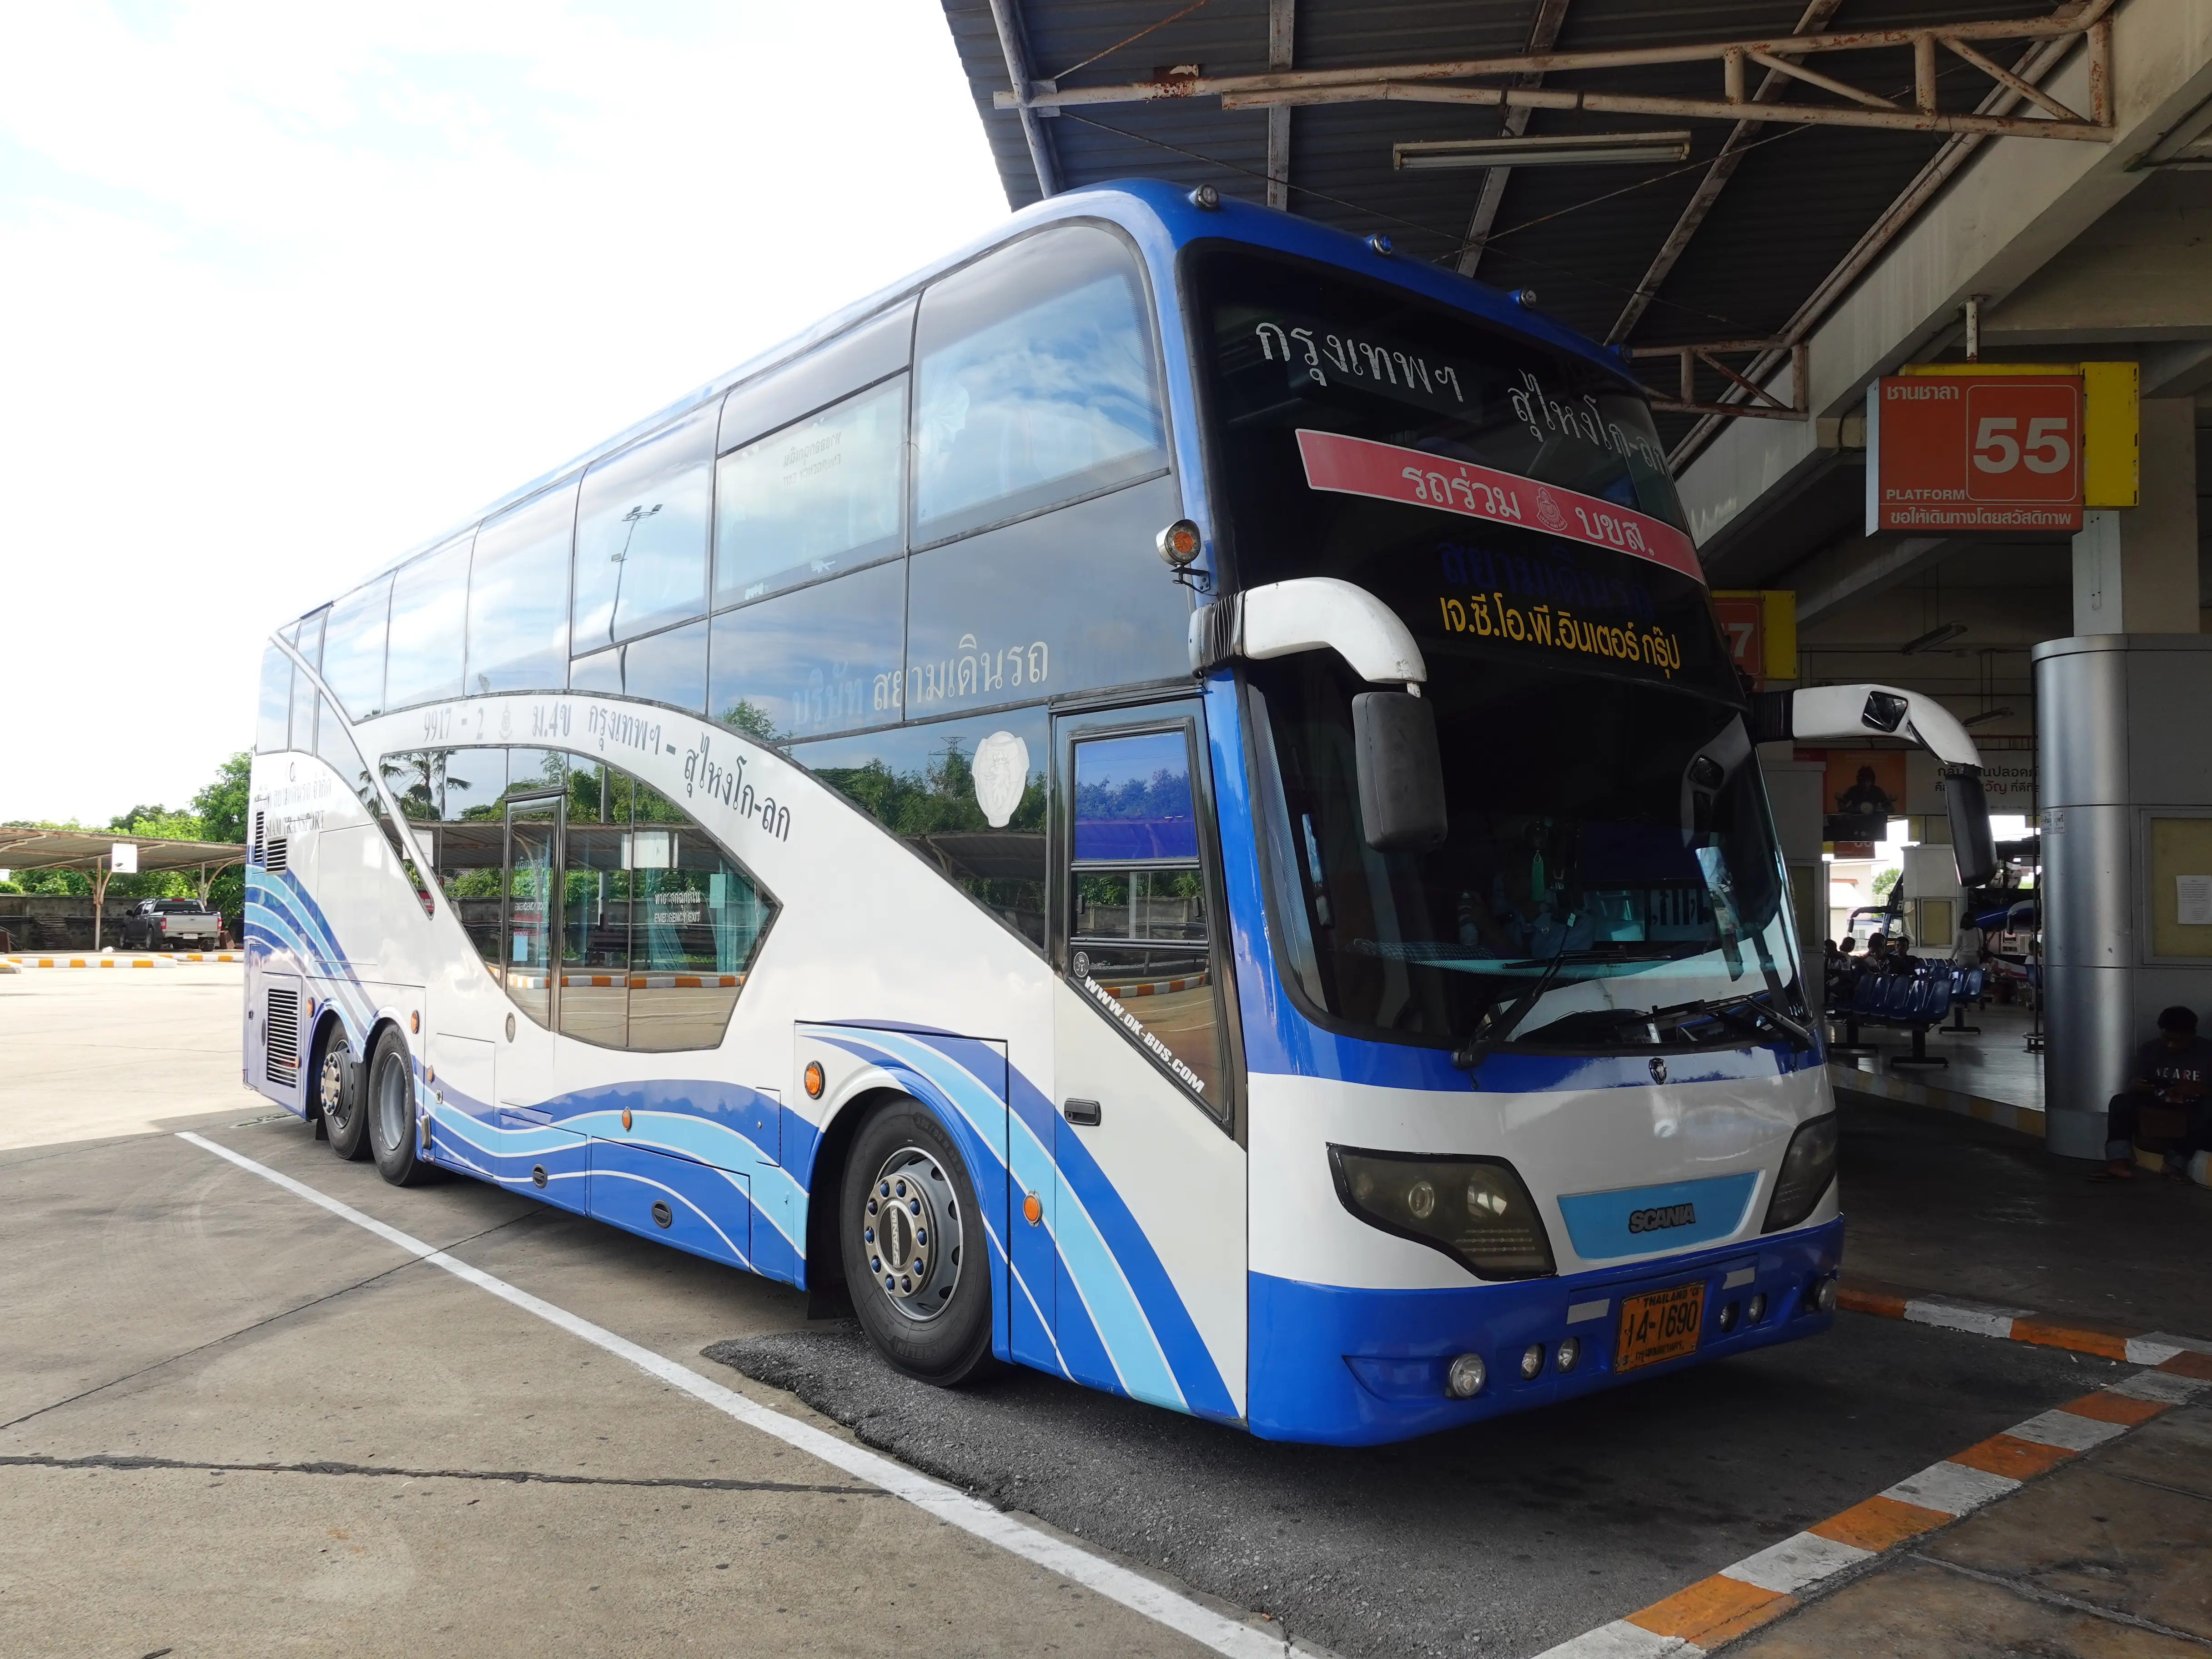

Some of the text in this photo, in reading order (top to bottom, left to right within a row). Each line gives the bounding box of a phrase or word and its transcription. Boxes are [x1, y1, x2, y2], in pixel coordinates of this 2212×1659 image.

[1256, 322, 1465, 402] กรุงเทพฯ
[1886, 385, 1959, 401] ชานชาลา
[1971, 417, 2071, 474] 55
[1402, 466, 1655, 556] รถร่วม บขส.
[1886, 489, 1965, 501] PLATFORM
[1890, 507, 2072, 526] ขอให้เดินทางโดยสวัสดิภาพ
[1720, 623, 1754, 658] 7
[873, 633, 1049, 710] สยามเดินรถ
[423, 707, 452, 742] 9917
[476, 707, 484, 740] 2
[532, 701, 572, 738] ม.4ข
[588, 705, 661, 755] กรุงเทพฯ
[684, 731, 790, 843] สุไหงโก-ลก
[274, 779, 311, 807] สยามเดนรถ
[265, 810, 326, 837] SIAM TRANSPORT
[654, 911, 701, 923] EMERGENCY EXIT
[1083, 975, 1206, 1094] WWW.OK-BUS.COM
[1629, 1202, 1696, 1234] SCANIA
[890, 1208, 901, 1267] SCANIA
[1644, 1289, 1688, 1307] THAILAND
[1627, 1299, 1699, 1348] 14-1690
